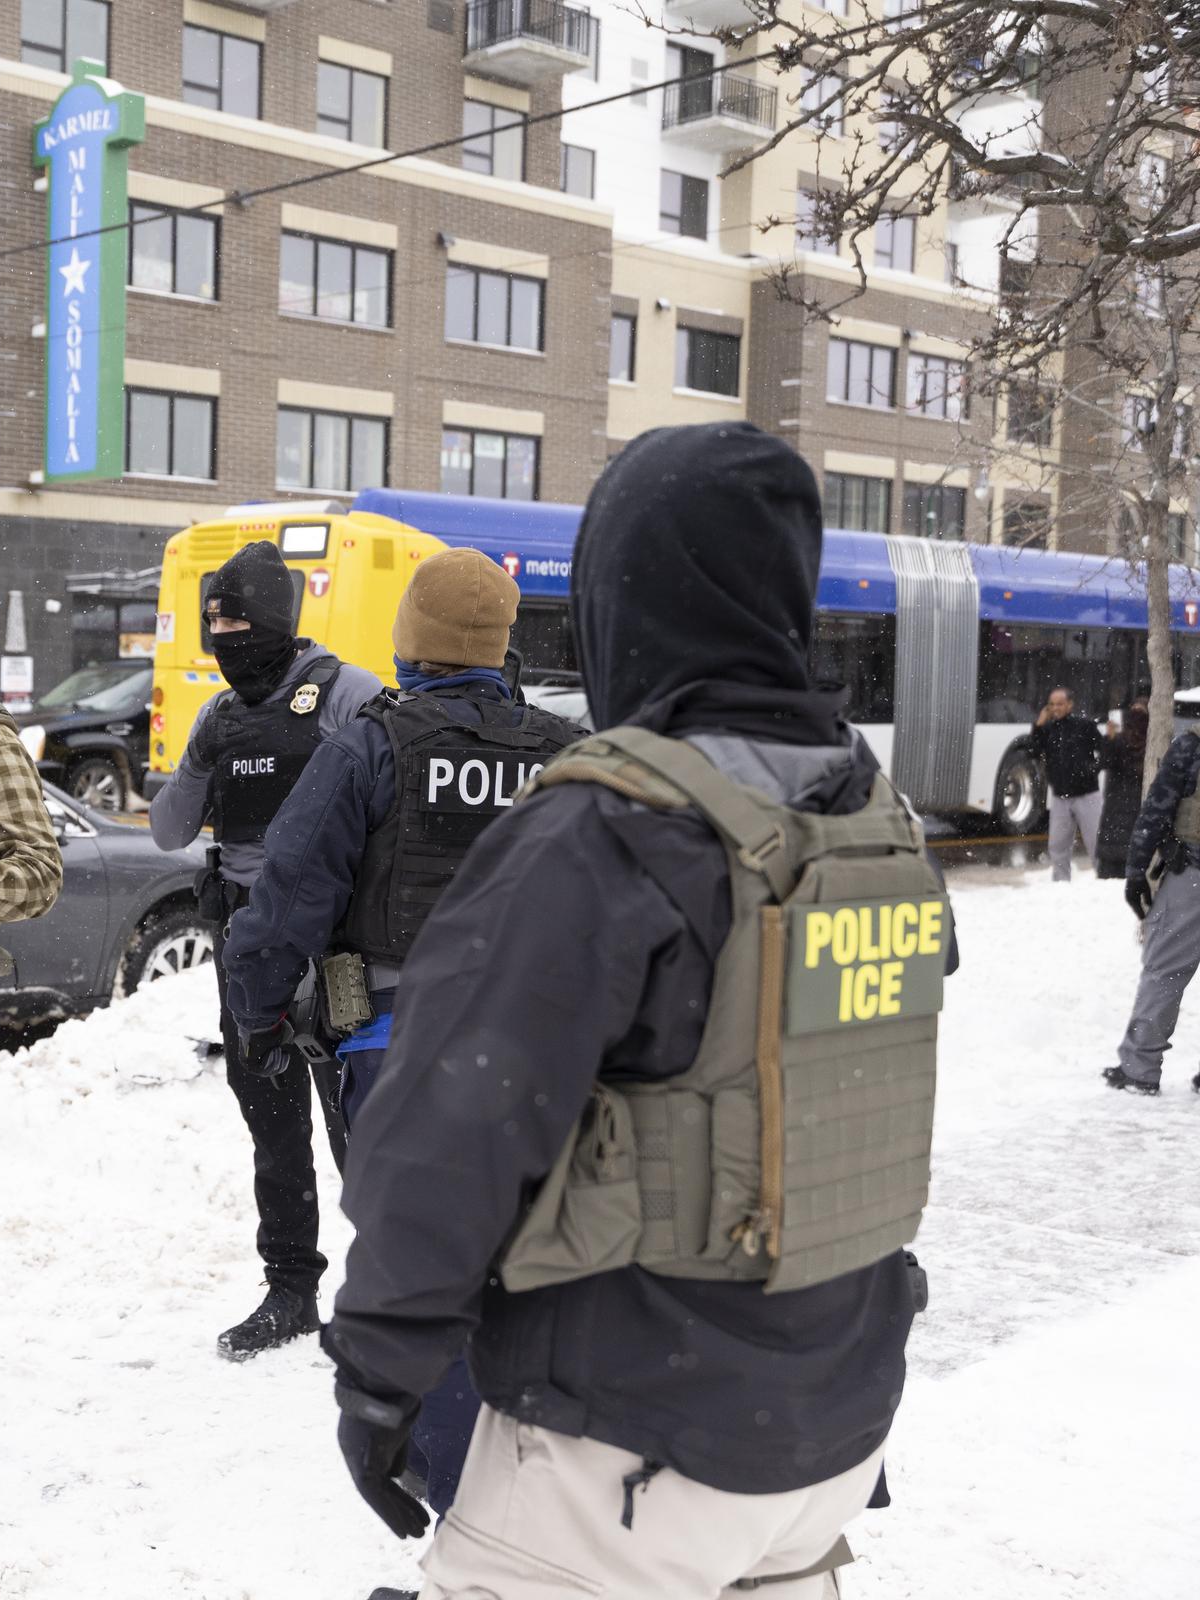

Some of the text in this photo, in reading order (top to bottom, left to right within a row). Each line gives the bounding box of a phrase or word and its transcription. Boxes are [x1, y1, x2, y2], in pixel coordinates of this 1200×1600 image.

[43, 109, 112, 150] KARMEL
[65, 299, 83, 464] SOMALIA
[232, 757, 275, 776] POLICE
[805, 901, 943, 968] POLICE
[839, 961, 904, 1022] ICE
